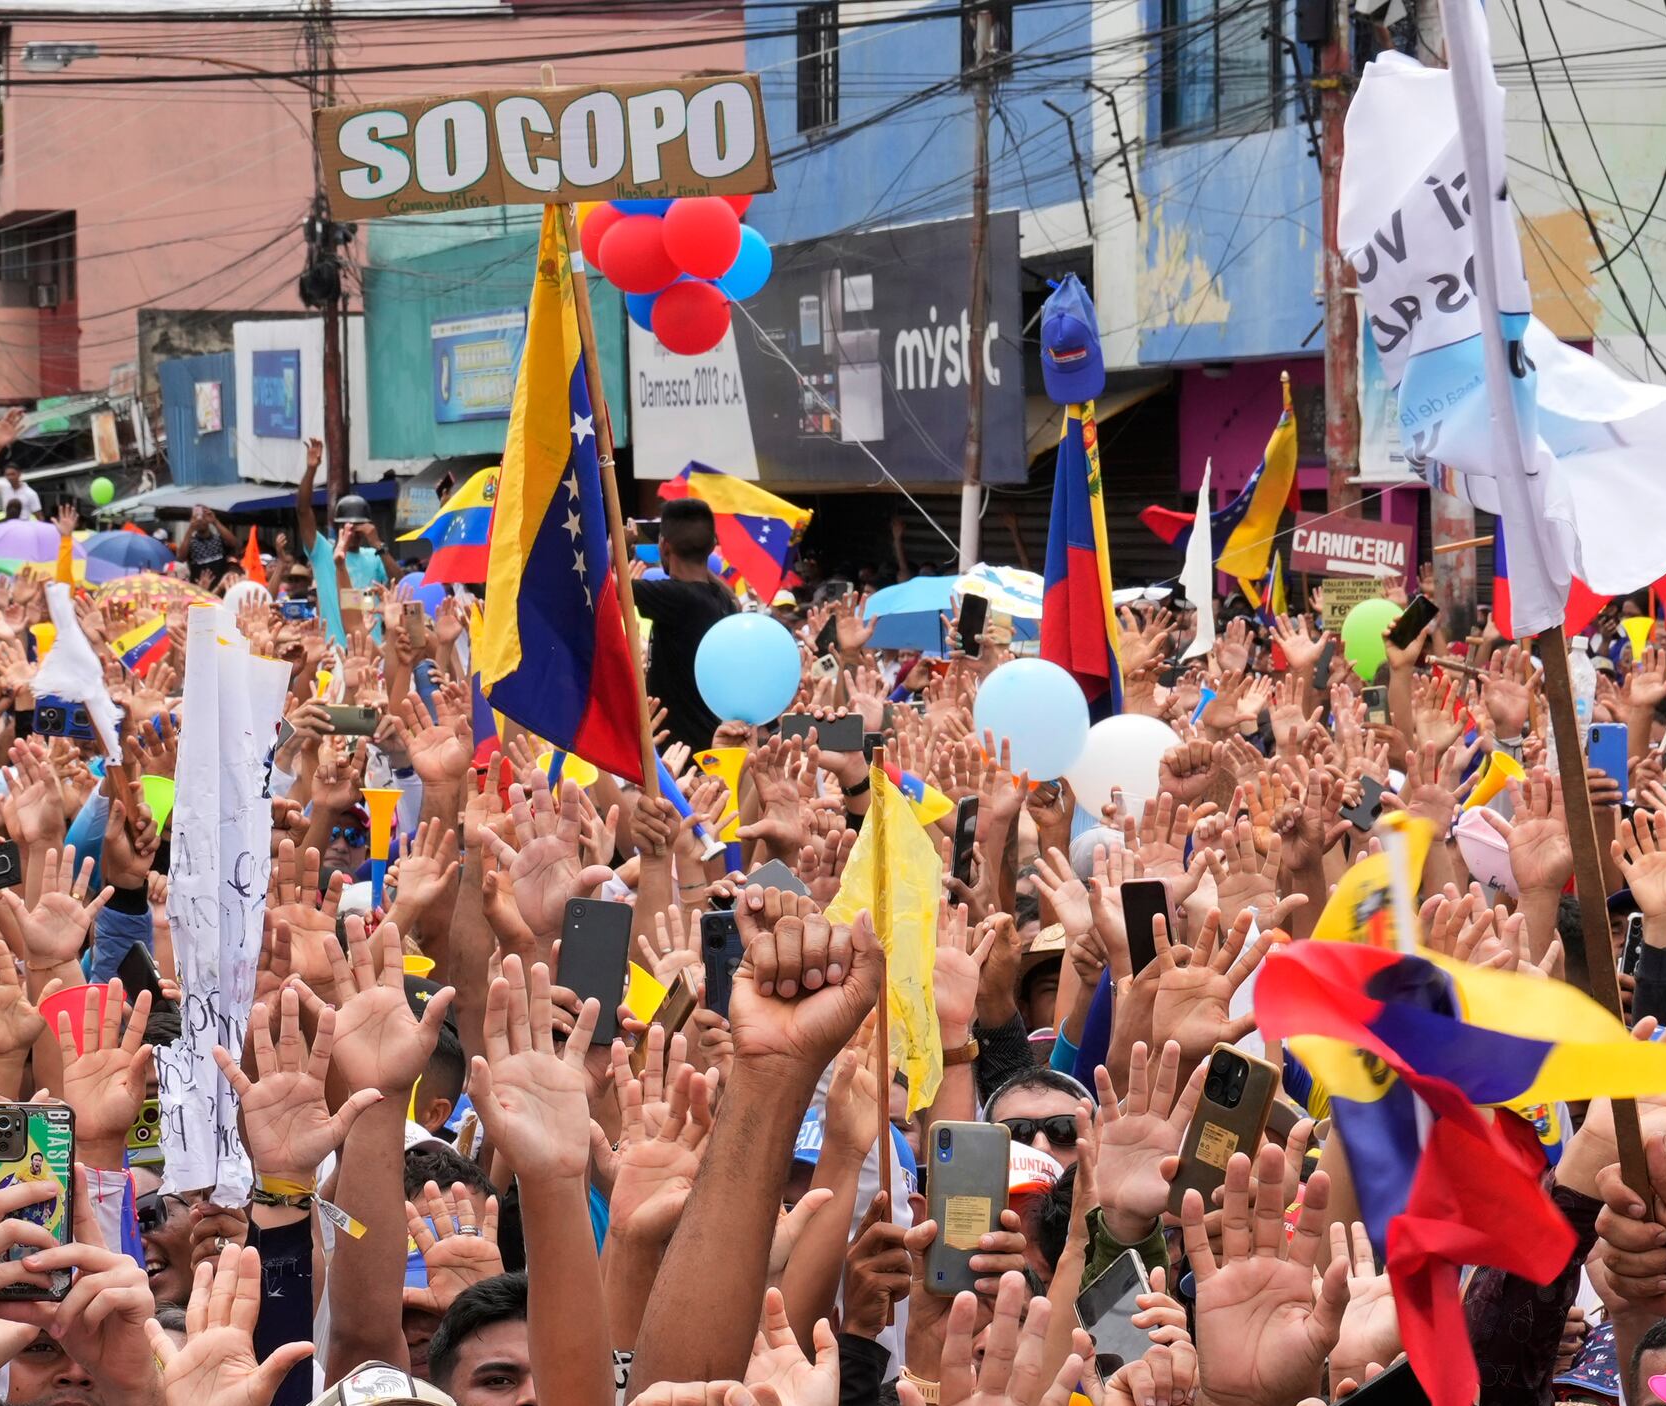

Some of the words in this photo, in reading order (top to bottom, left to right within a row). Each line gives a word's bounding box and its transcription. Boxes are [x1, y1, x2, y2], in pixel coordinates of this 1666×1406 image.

[895, 305, 1001, 391] mystc
[639, 371, 691, 409] Damasco
[693, 368, 720, 406] 2013
[1292, 528, 1405, 566] CARNICERIA
